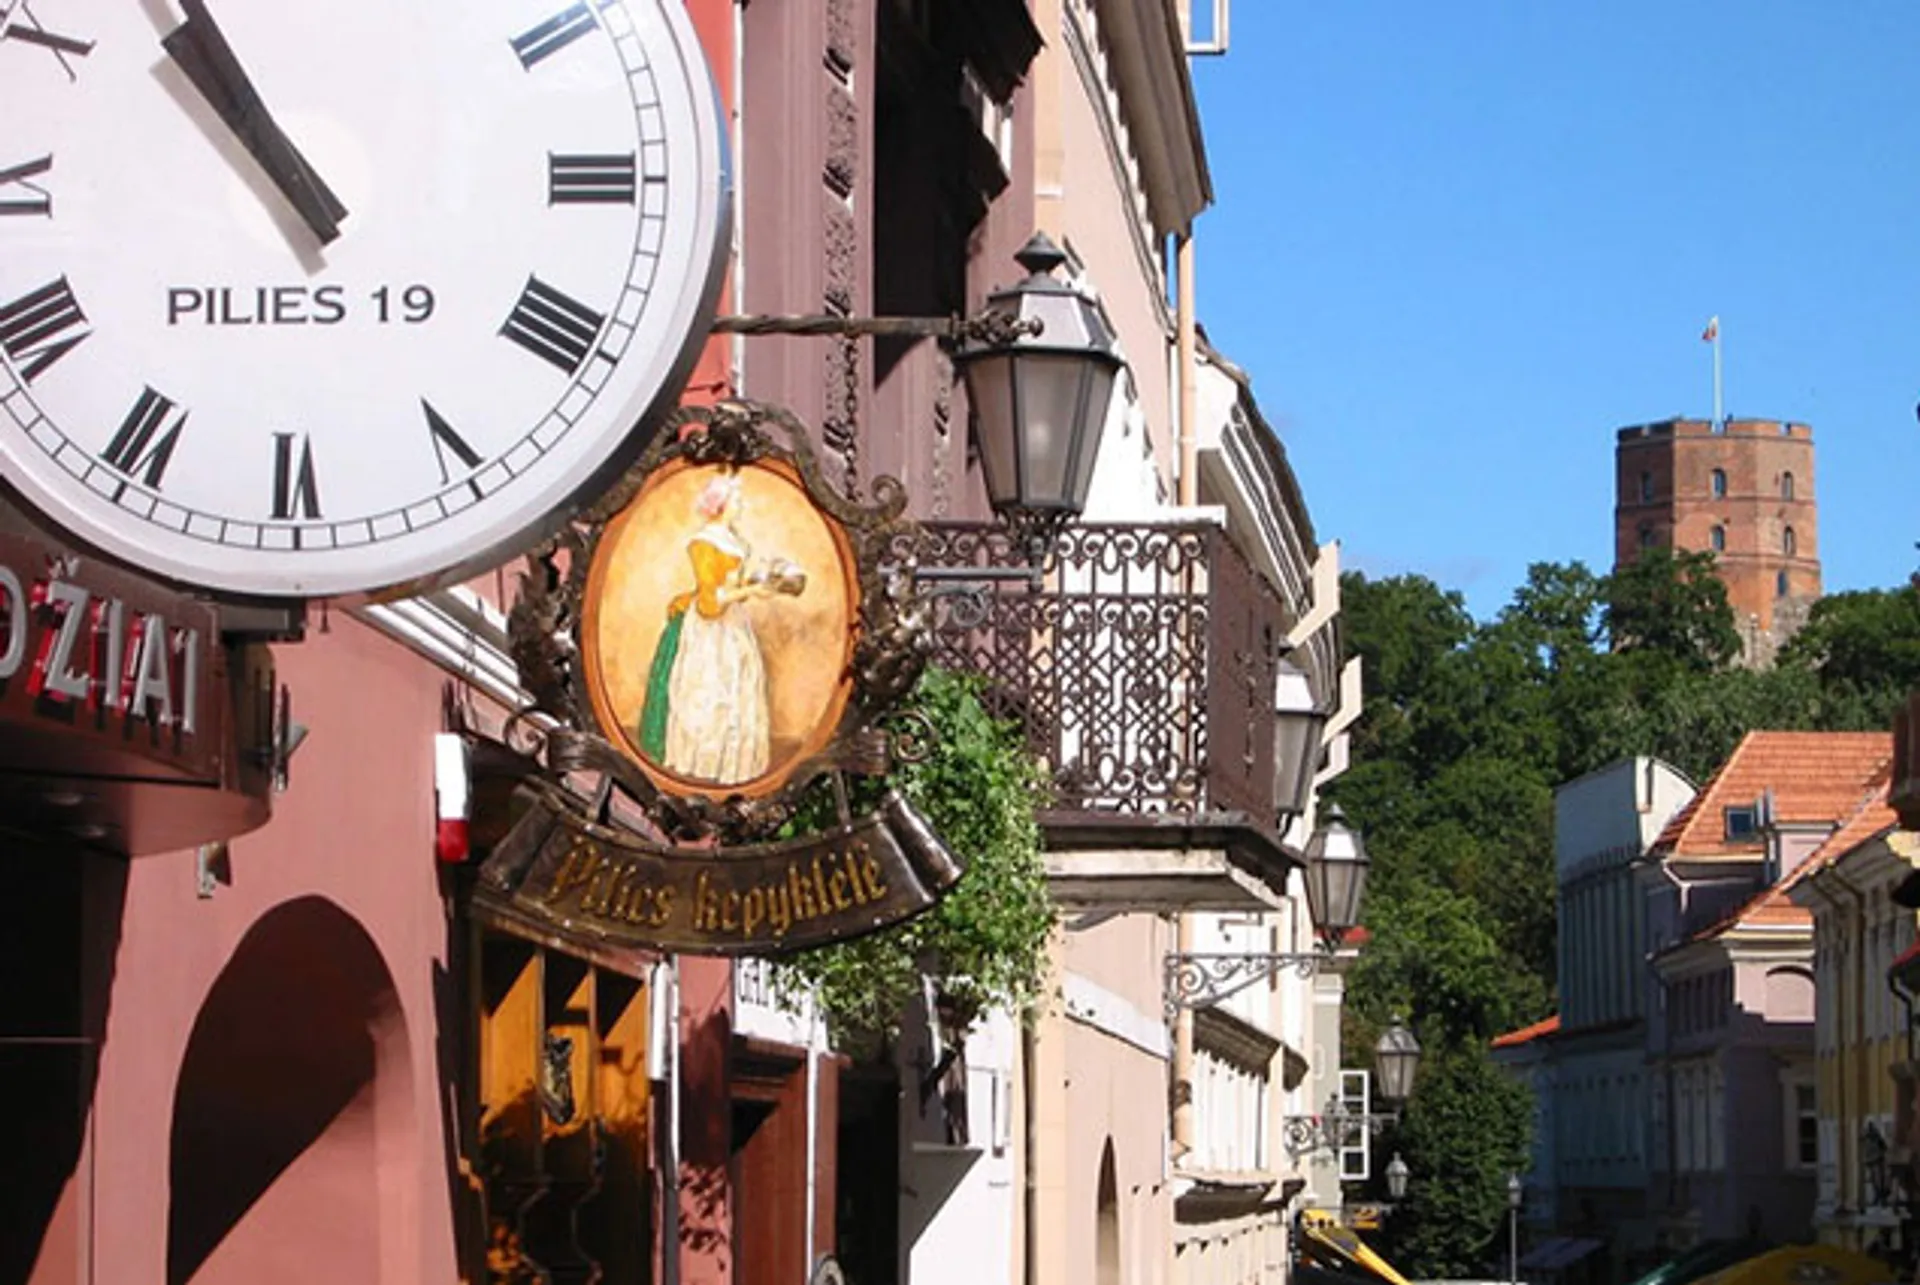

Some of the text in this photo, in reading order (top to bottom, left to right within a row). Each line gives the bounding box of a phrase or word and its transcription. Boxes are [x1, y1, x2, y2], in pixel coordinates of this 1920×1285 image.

[547, 150, 636, 207] III
[167, 285, 435, 325] PILIES 19
